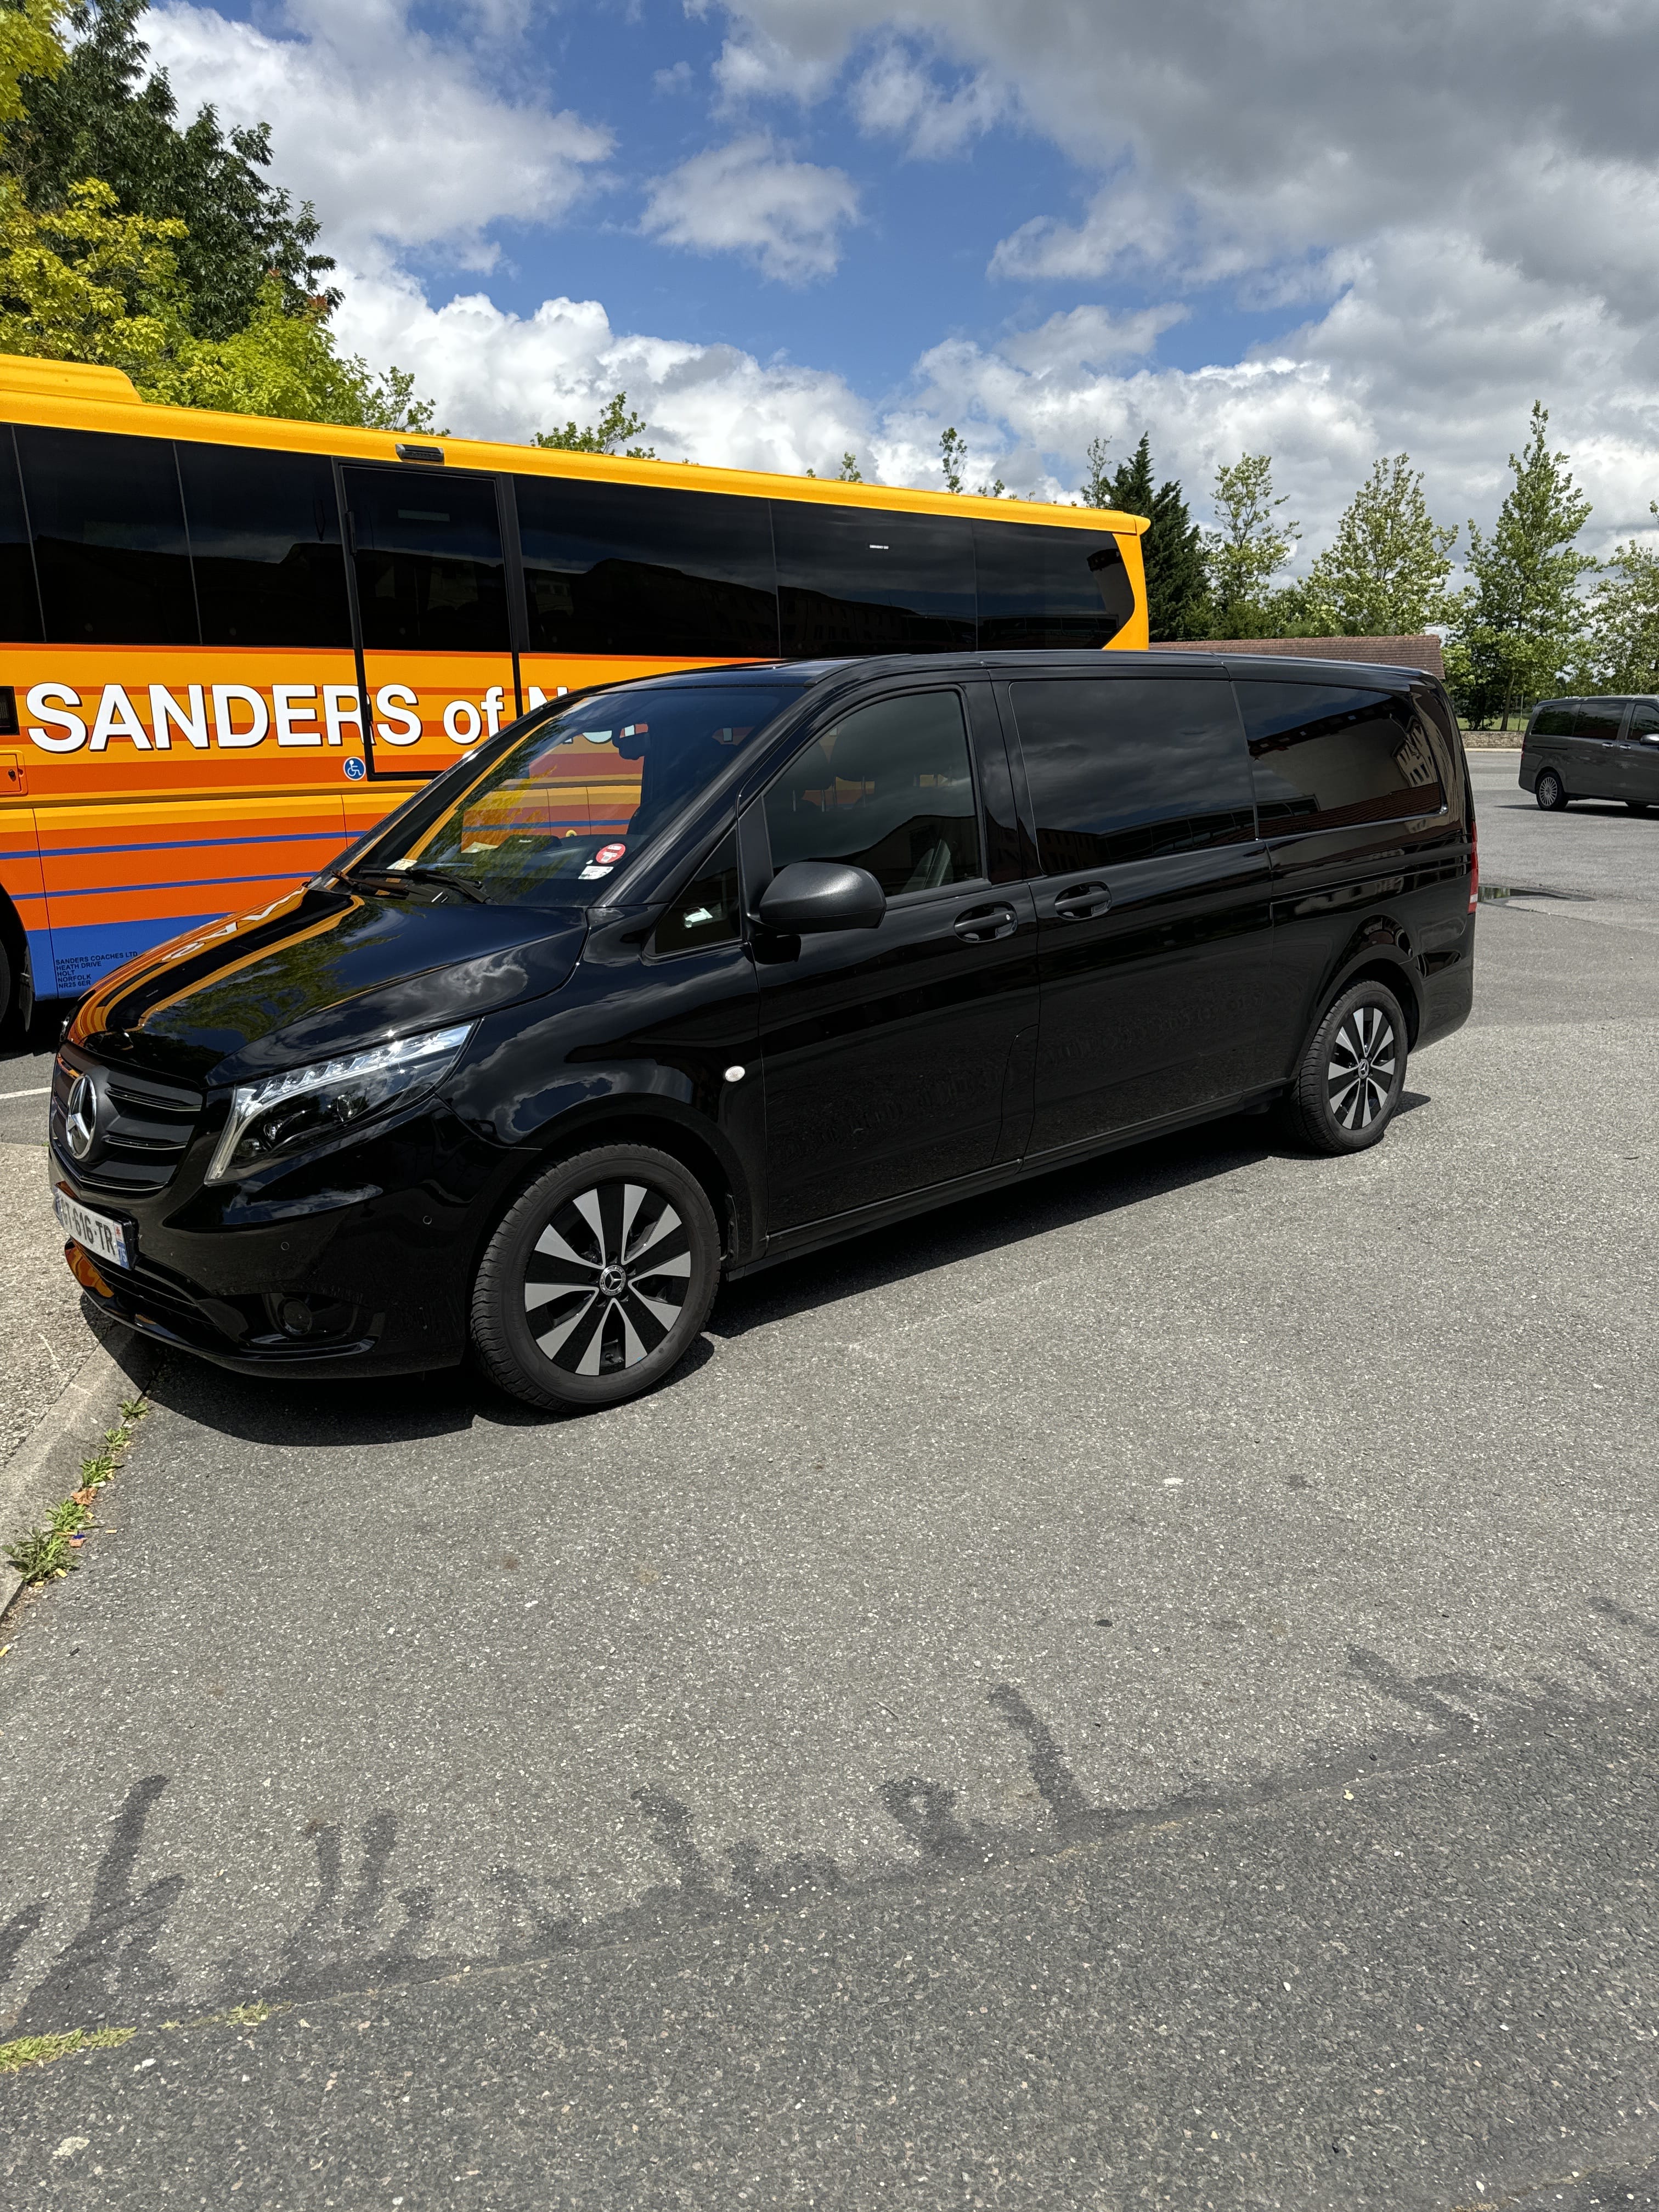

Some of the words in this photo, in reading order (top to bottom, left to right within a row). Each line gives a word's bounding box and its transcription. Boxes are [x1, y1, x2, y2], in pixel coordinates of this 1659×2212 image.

[26, 682, 422, 753] SANDERS
[443, 686, 504, 745] of
[55, 957, 88, 965] SANDERS
[91, 952, 124, 961] COACHES
[58, 974, 92, 983] NORFOLK
[118, 1246, 127, 1263] 75
